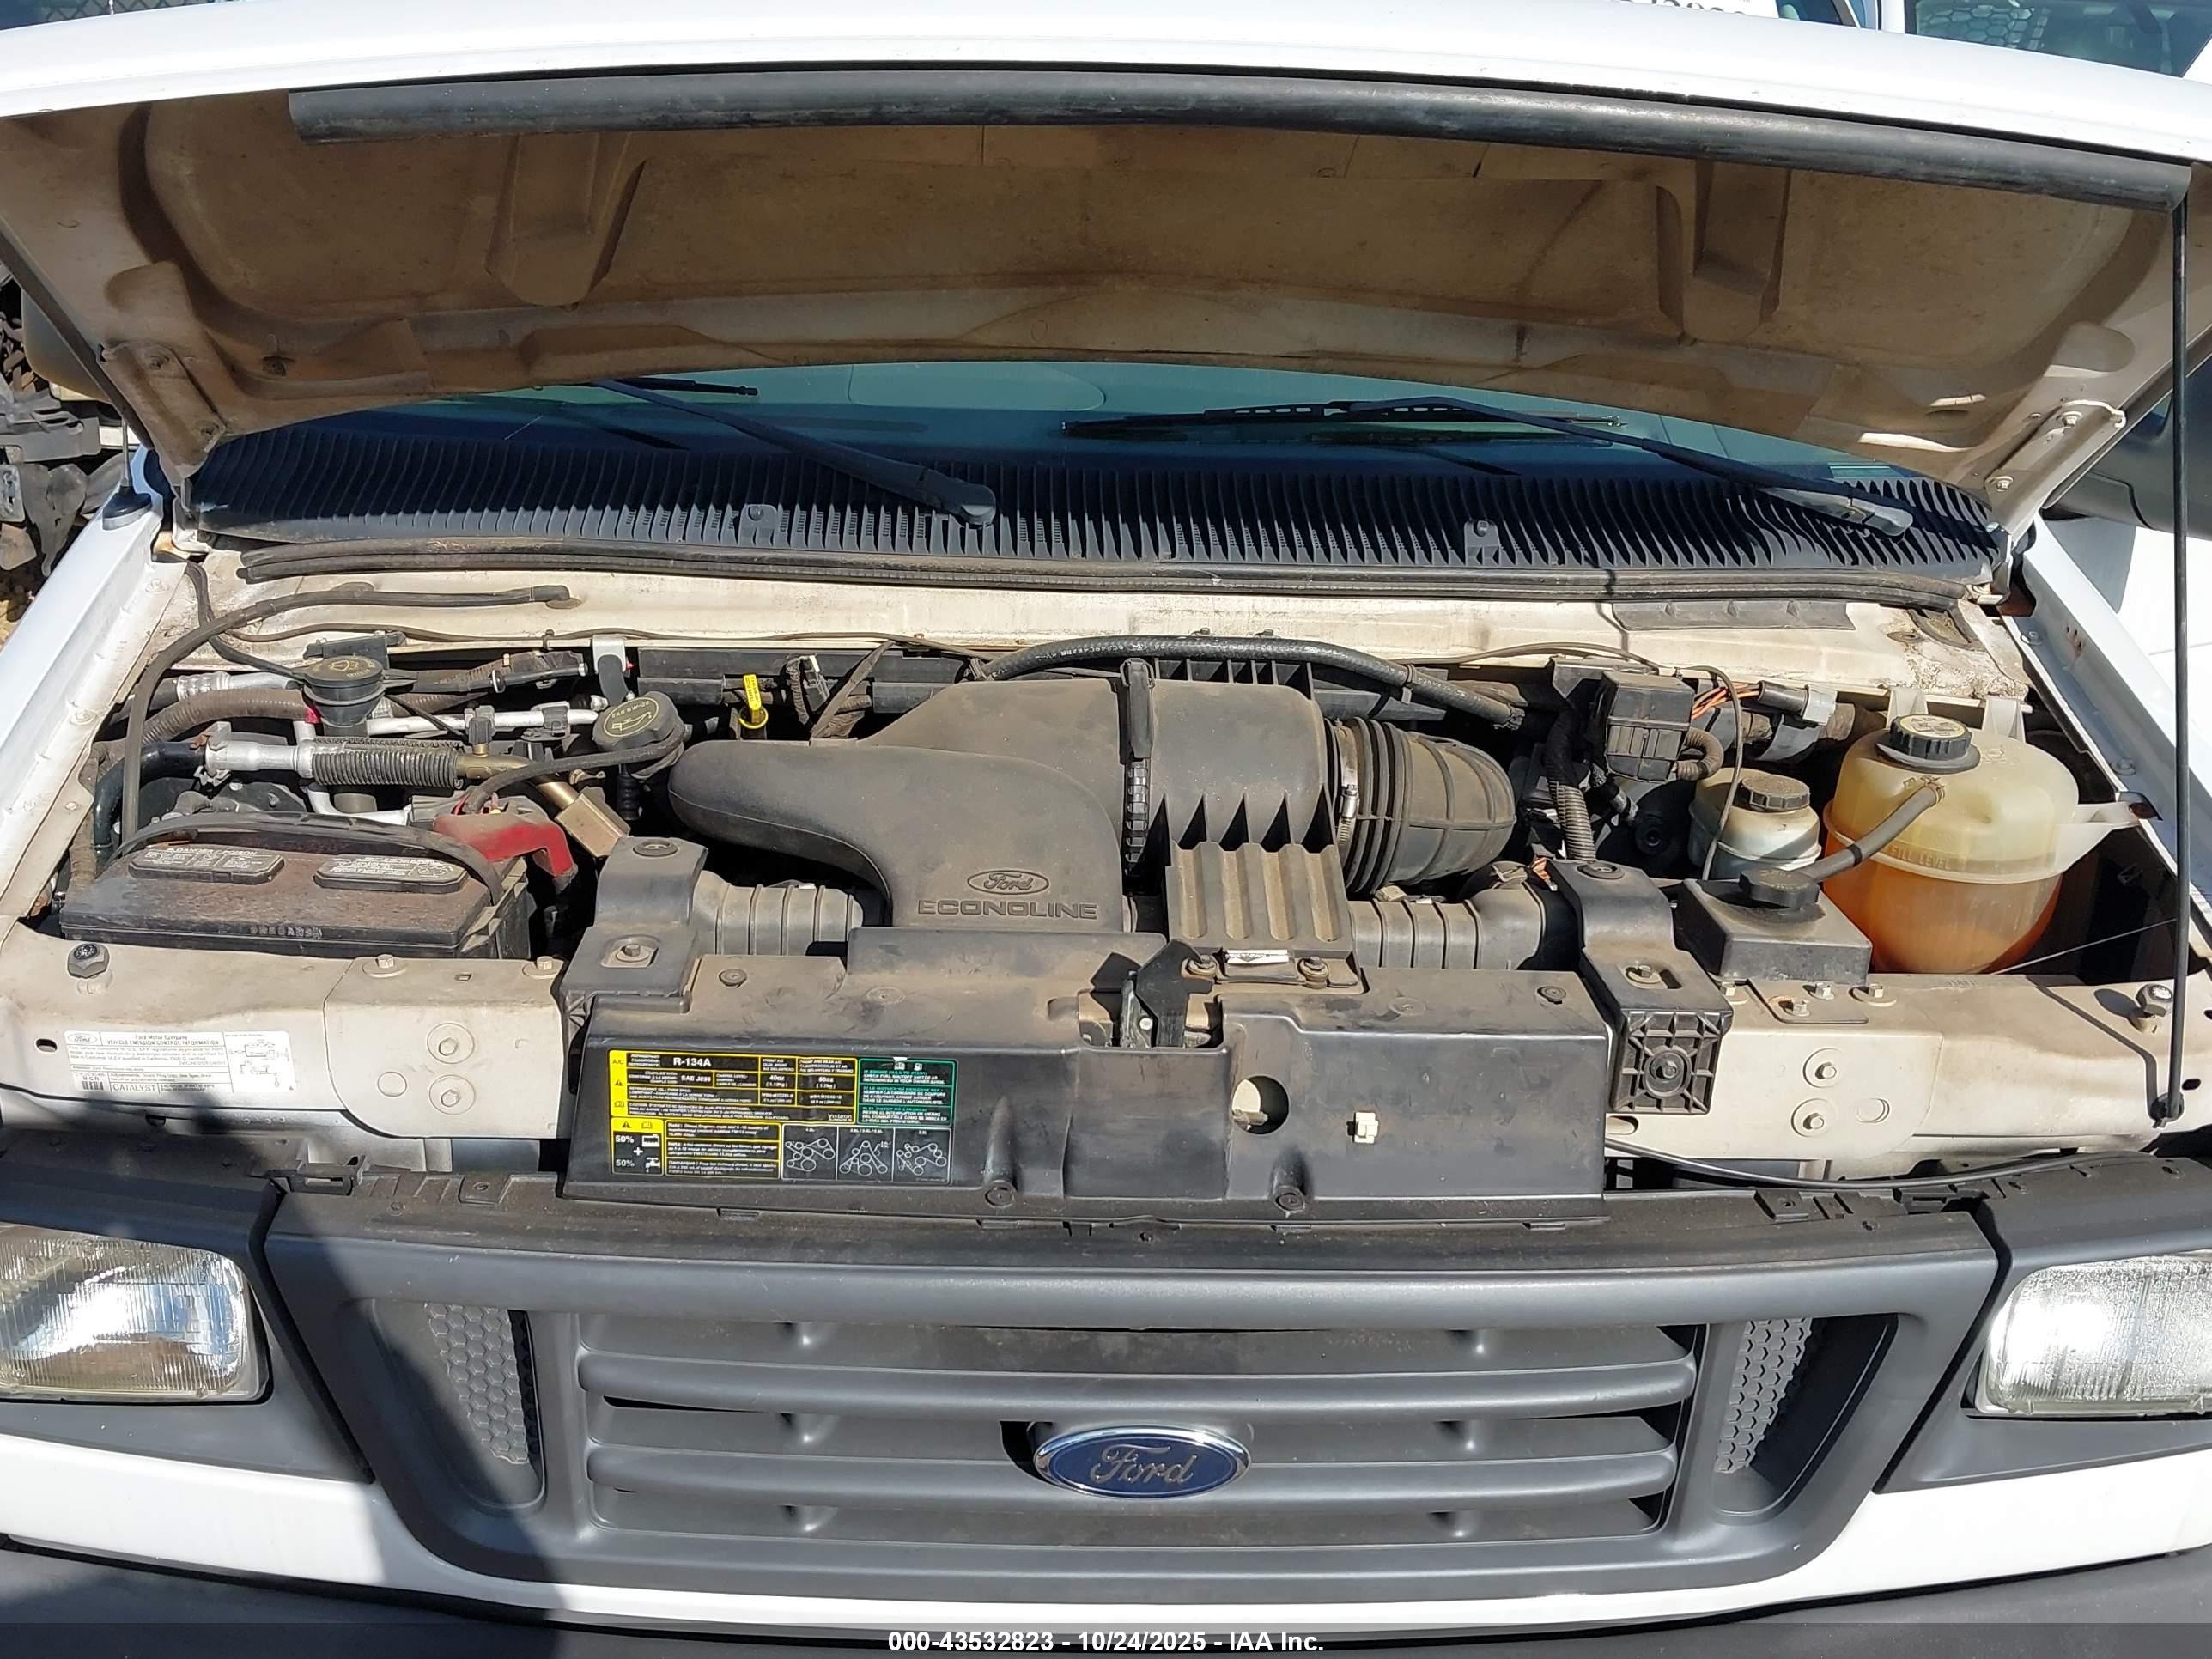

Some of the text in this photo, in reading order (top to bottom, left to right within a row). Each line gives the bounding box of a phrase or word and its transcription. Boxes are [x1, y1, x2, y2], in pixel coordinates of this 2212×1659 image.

[1892, 845, 1952, 870] FILL LEVEL
[983, 872, 1033, 890] Ford
[918, 899, 1097, 920] ECONOLINE
[673, 1057, 712, 1066] R-134A
[112, 1083, 156, 1092] CATALYST
[616, 1134, 635, 1144] 50%
[1090, 1443, 1197, 1485] Ford
